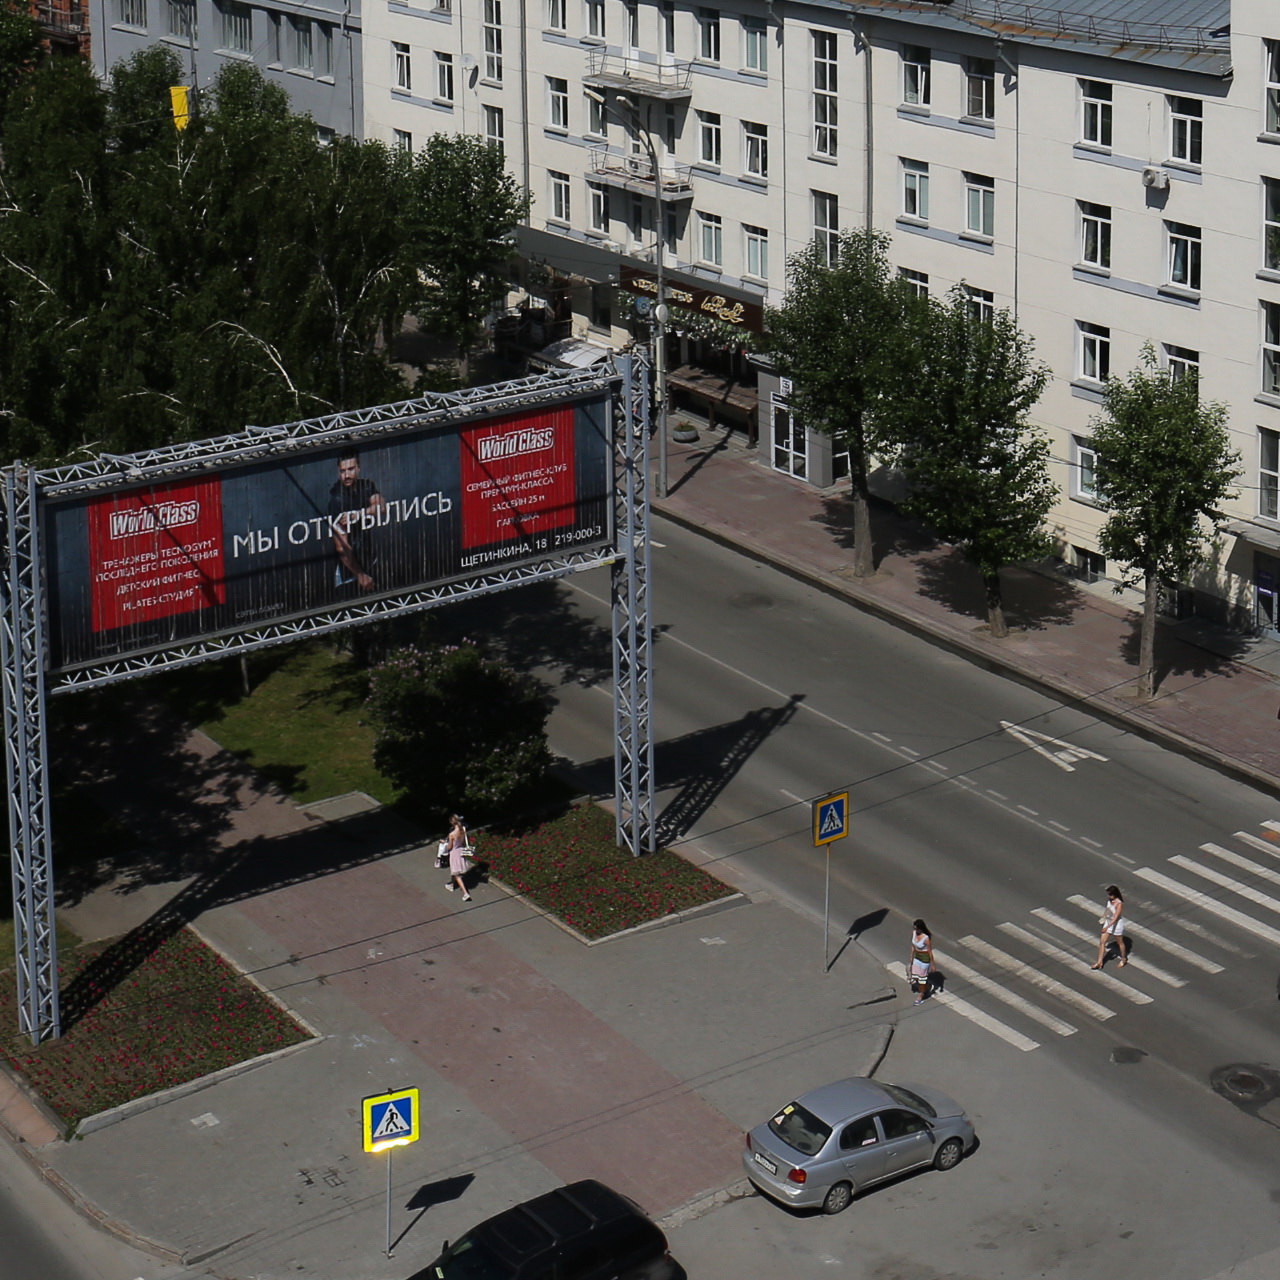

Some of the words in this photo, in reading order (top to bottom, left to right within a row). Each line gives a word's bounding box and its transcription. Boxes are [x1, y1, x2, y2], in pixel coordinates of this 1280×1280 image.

[481, 434, 517, 460] World
[518, 431, 553, 452] Class
[467, 474, 509, 492] СЕМЕЙНЫЙ
[481, 477, 554, 499] ПРЕМИУМ-КЛАССА
[492, 496, 527, 512] БАССЕЙН
[528, 495, 537, 504] 25
[112, 508, 155, 536] World
[158, 502, 197, 528] Class
[233, 526, 279, 558] МЫ
[288, 491, 453, 545] ОТКРЫЛИСЬ
[461, 543, 532, 567] ЩЕТИНКИНА,
[535, 538, 547, 549] 18
[555, 525, 602, 545] 219-000-3
[96, 561, 158, 582] ПОСЛЕДНЕГО
[160, 549, 219, 569] ПОКОЛЕНИЯ
[103, 551, 159, 570] ТРЕНАЖЕРЫ
[116, 577, 160, 595] ДЕТСКИЙ
[161, 569, 201, 585] ФИТНЕС
